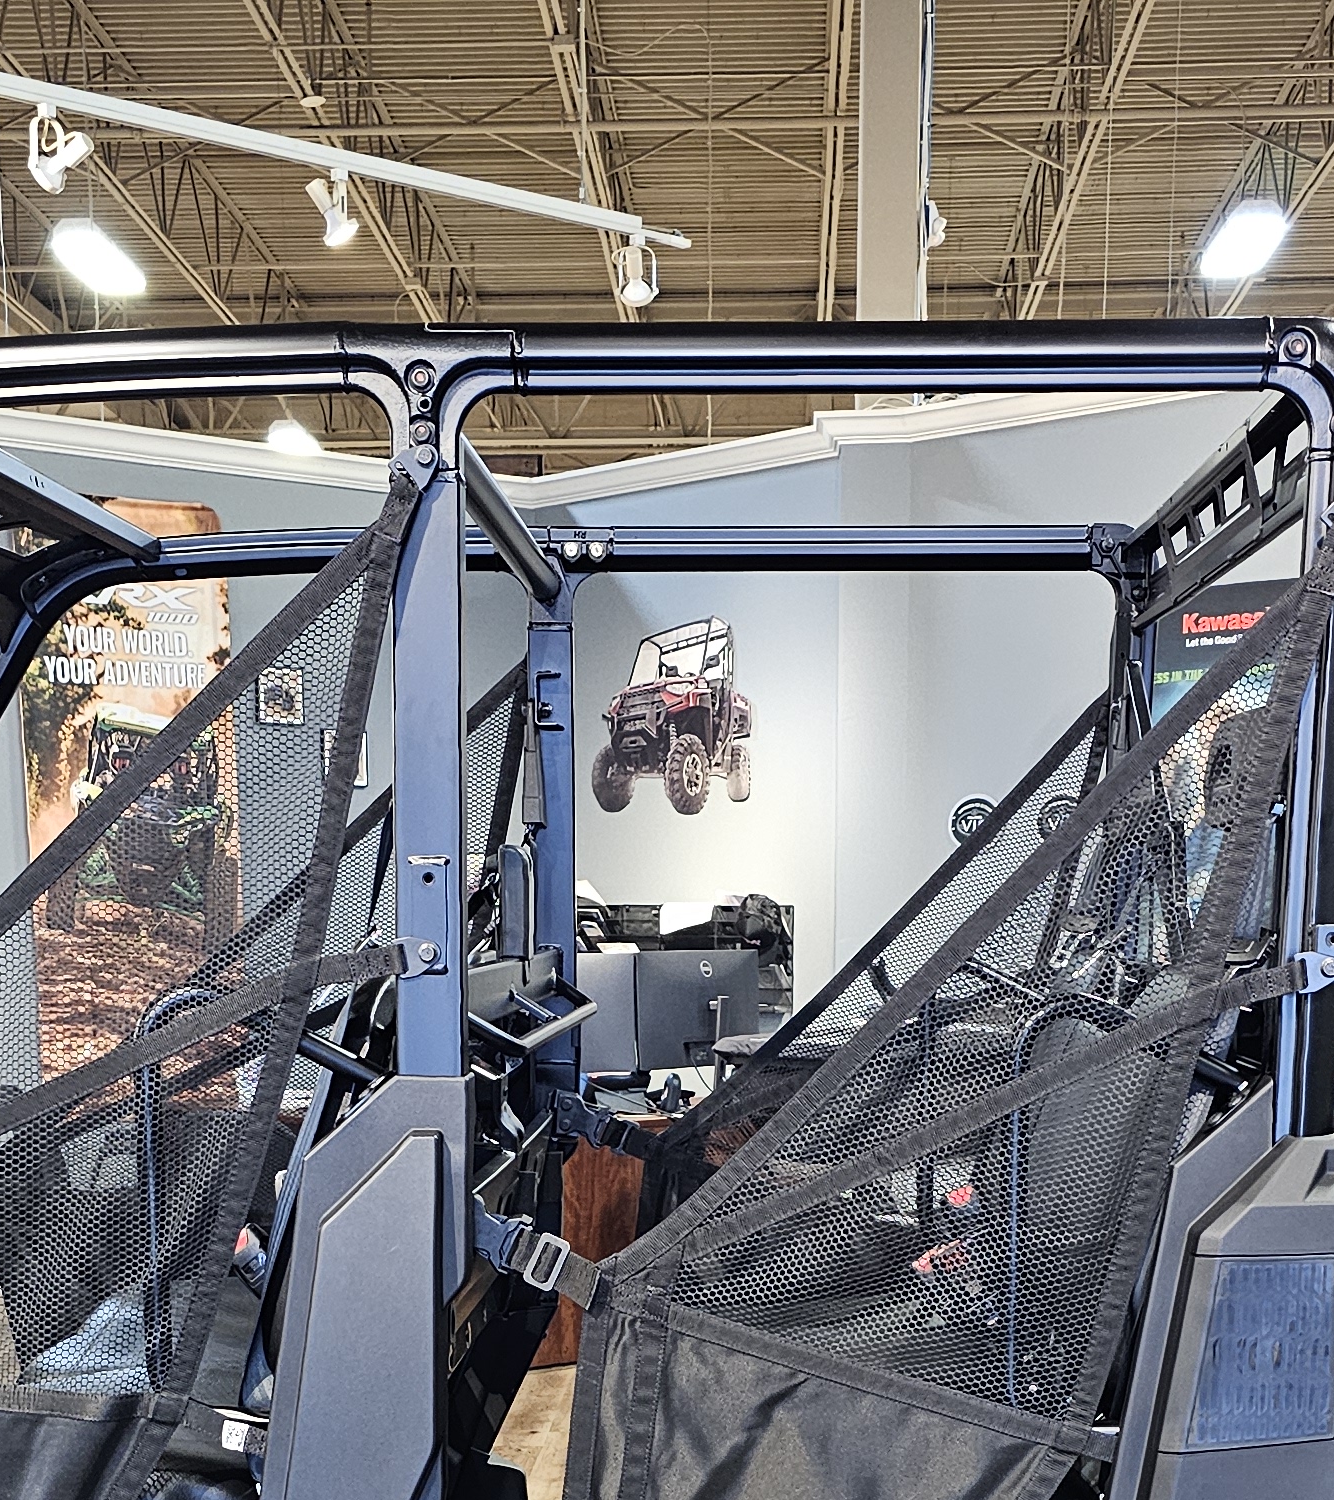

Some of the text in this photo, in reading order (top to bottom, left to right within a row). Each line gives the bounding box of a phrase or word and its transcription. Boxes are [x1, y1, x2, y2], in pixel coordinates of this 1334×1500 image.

[146, 611, 199, 625] 1000
[1182, 612, 1265, 634] Kawasa
[63, 624, 193, 657] YOUR WORLD.
[1186, 638, 1199, 648] Let
[1200, 637, 1214, 646] the
[1215, 635, 1238, 645] Good
[43, 655, 206, 689] YOUR ADVENTURE
